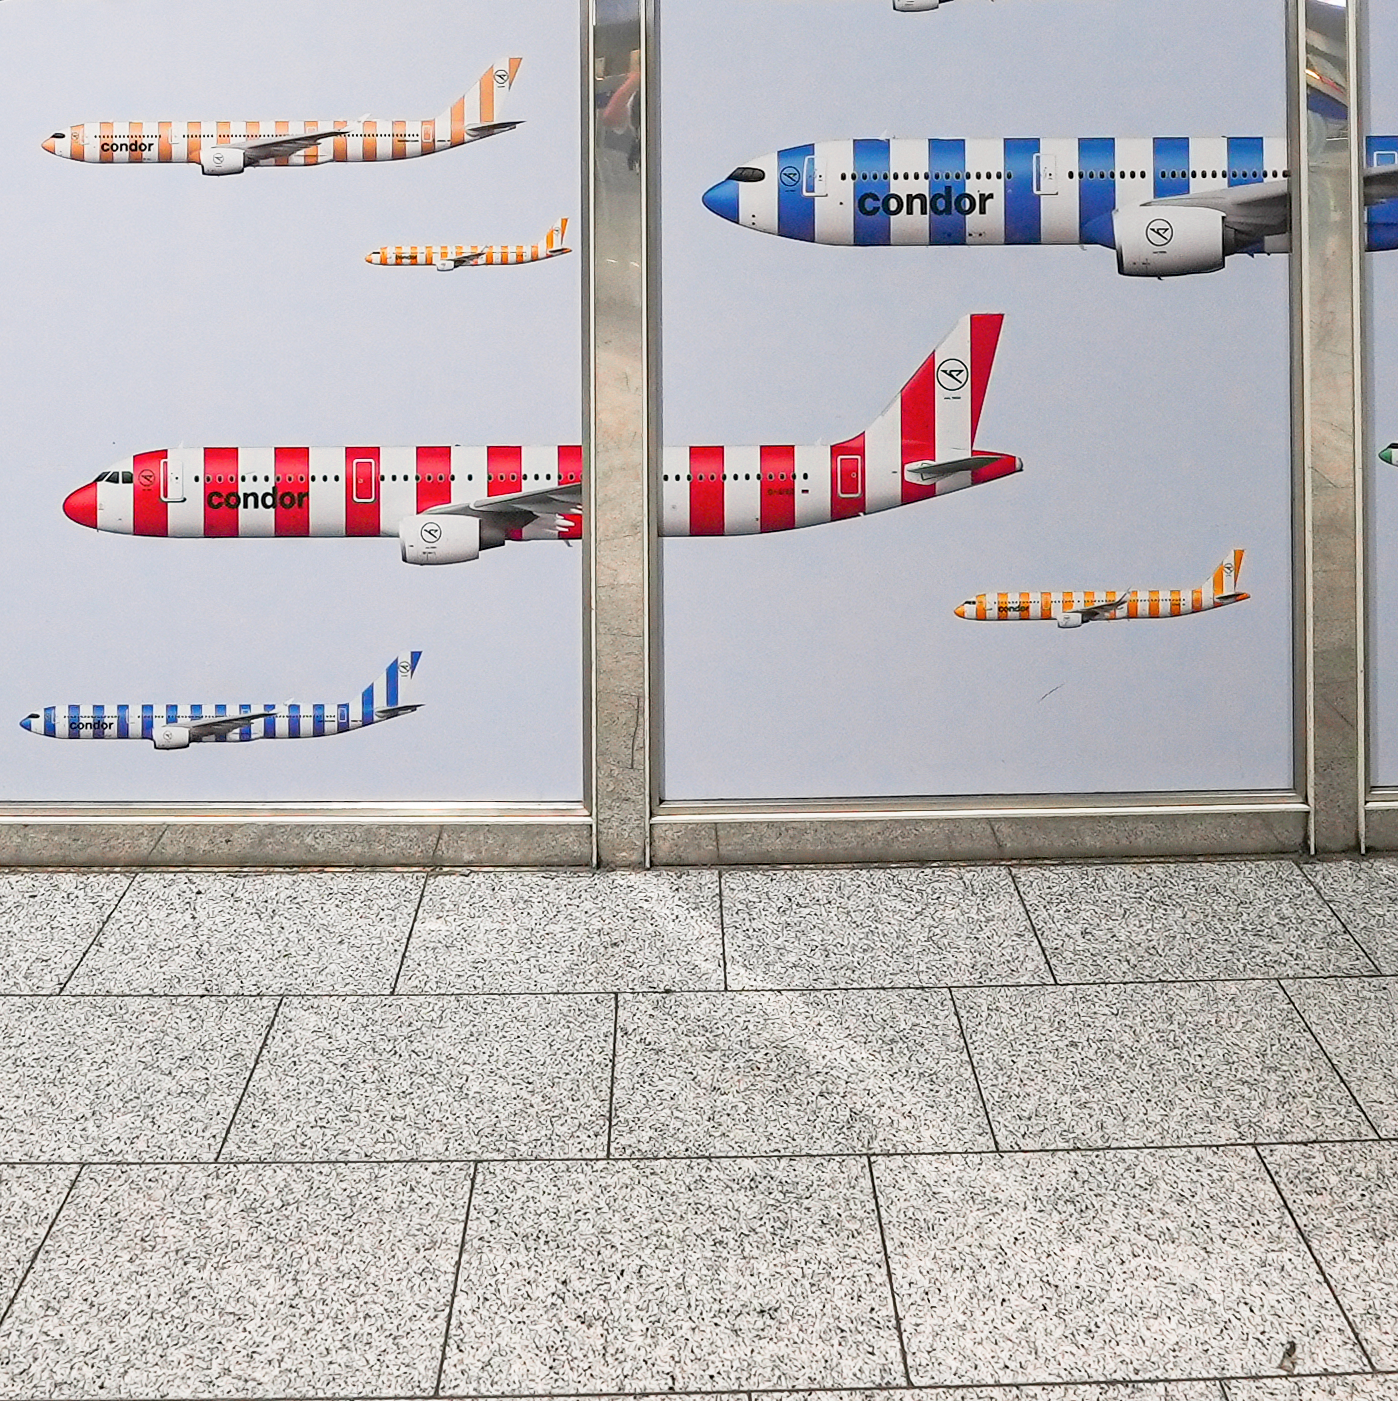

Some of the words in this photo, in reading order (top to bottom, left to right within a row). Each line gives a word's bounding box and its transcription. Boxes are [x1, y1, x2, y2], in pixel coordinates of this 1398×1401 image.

[100, 139, 154, 152] condor
[858, 185, 994, 216] condor
[207, 486, 310, 510] condor
[69, 719, 115, 730] condor
